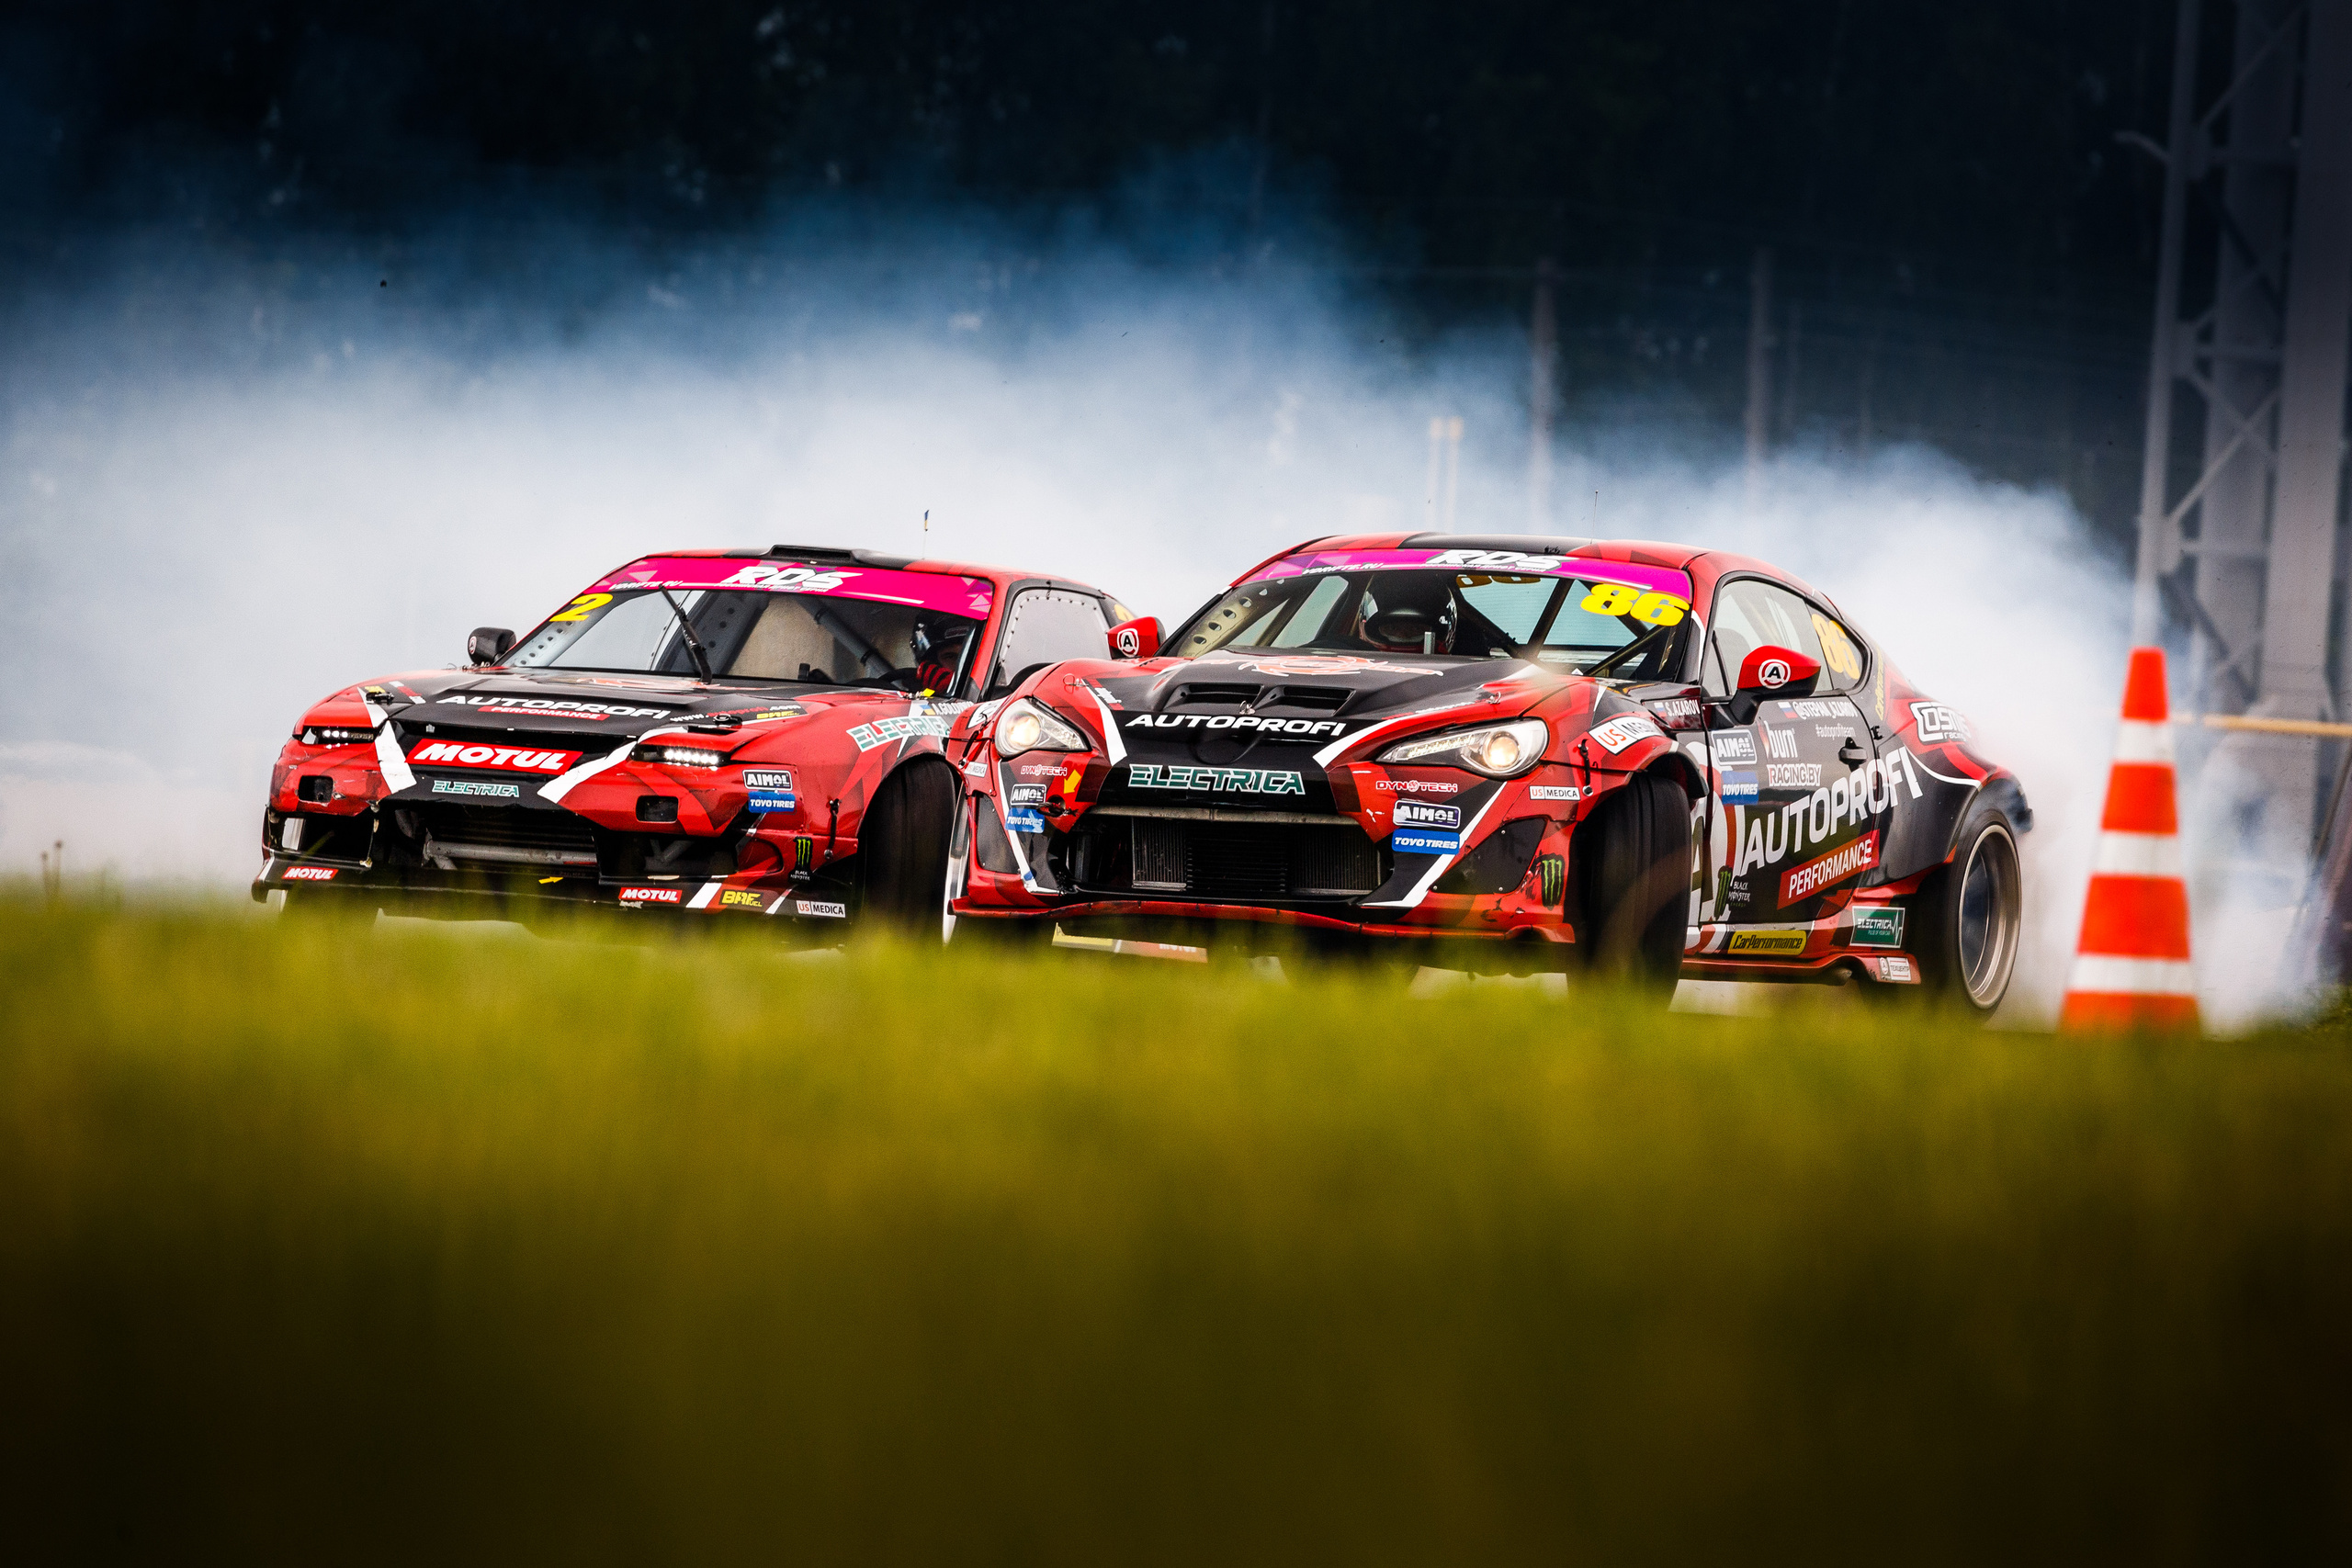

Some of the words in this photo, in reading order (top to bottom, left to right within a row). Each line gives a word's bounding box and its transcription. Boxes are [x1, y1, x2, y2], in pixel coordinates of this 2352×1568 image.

[1426, 549, 1580, 570] RDS
[720, 566, 864, 589] RDS
[548, 592, 614, 622] 2
[1580, 583, 1690, 626] 86
[1123, 635, 1134, 648] A
[1812, 614, 1860, 680] 86
[1767, 666, 1781, 680] A
[435, 695, 672, 720] AUTOPROFI
[491, 706, 601, 720] PERFORMANCE
[1665, 699, 1701, 716] S.AZAROV
[1125, 714, 1347, 736] AUTOPROFI
[1598, 728, 1627, 747] US
[413, 743, 567, 771] MOTUL
[747, 773, 790, 786] AIMOL
[1127, 763, 1306, 795] ELECTRICA
[1766, 762, 1807, 787] RACING
[1807, 763, 1822, 787] BY
[432, 780, 520, 798] ELECTRICA
[1532, 788, 1544, 797] US
[1546, 789, 1578, 798] MEDICA
[750, 799, 772, 807] TOYO
[772, 799, 795, 808] TIRES
[1741, 746, 1924, 877] AUTOPROFI
[1397, 805, 1457, 822] AIMOL
[1395, 837, 1425, 847] TOYO
[1425, 839, 1458, 850] TIRES
[284, 867, 334, 880] MOTUL
[1789, 838, 1871, 899] PERFORMANCE
[622, 888, 679, 902] MOTUL
[798, 903, 809, 912] US
[812, 904, 844, 915] MEDICA
[1857, 918, 1893, 930] ELECTRICA
[1733, 934, 1804, 950] CarPerformance
